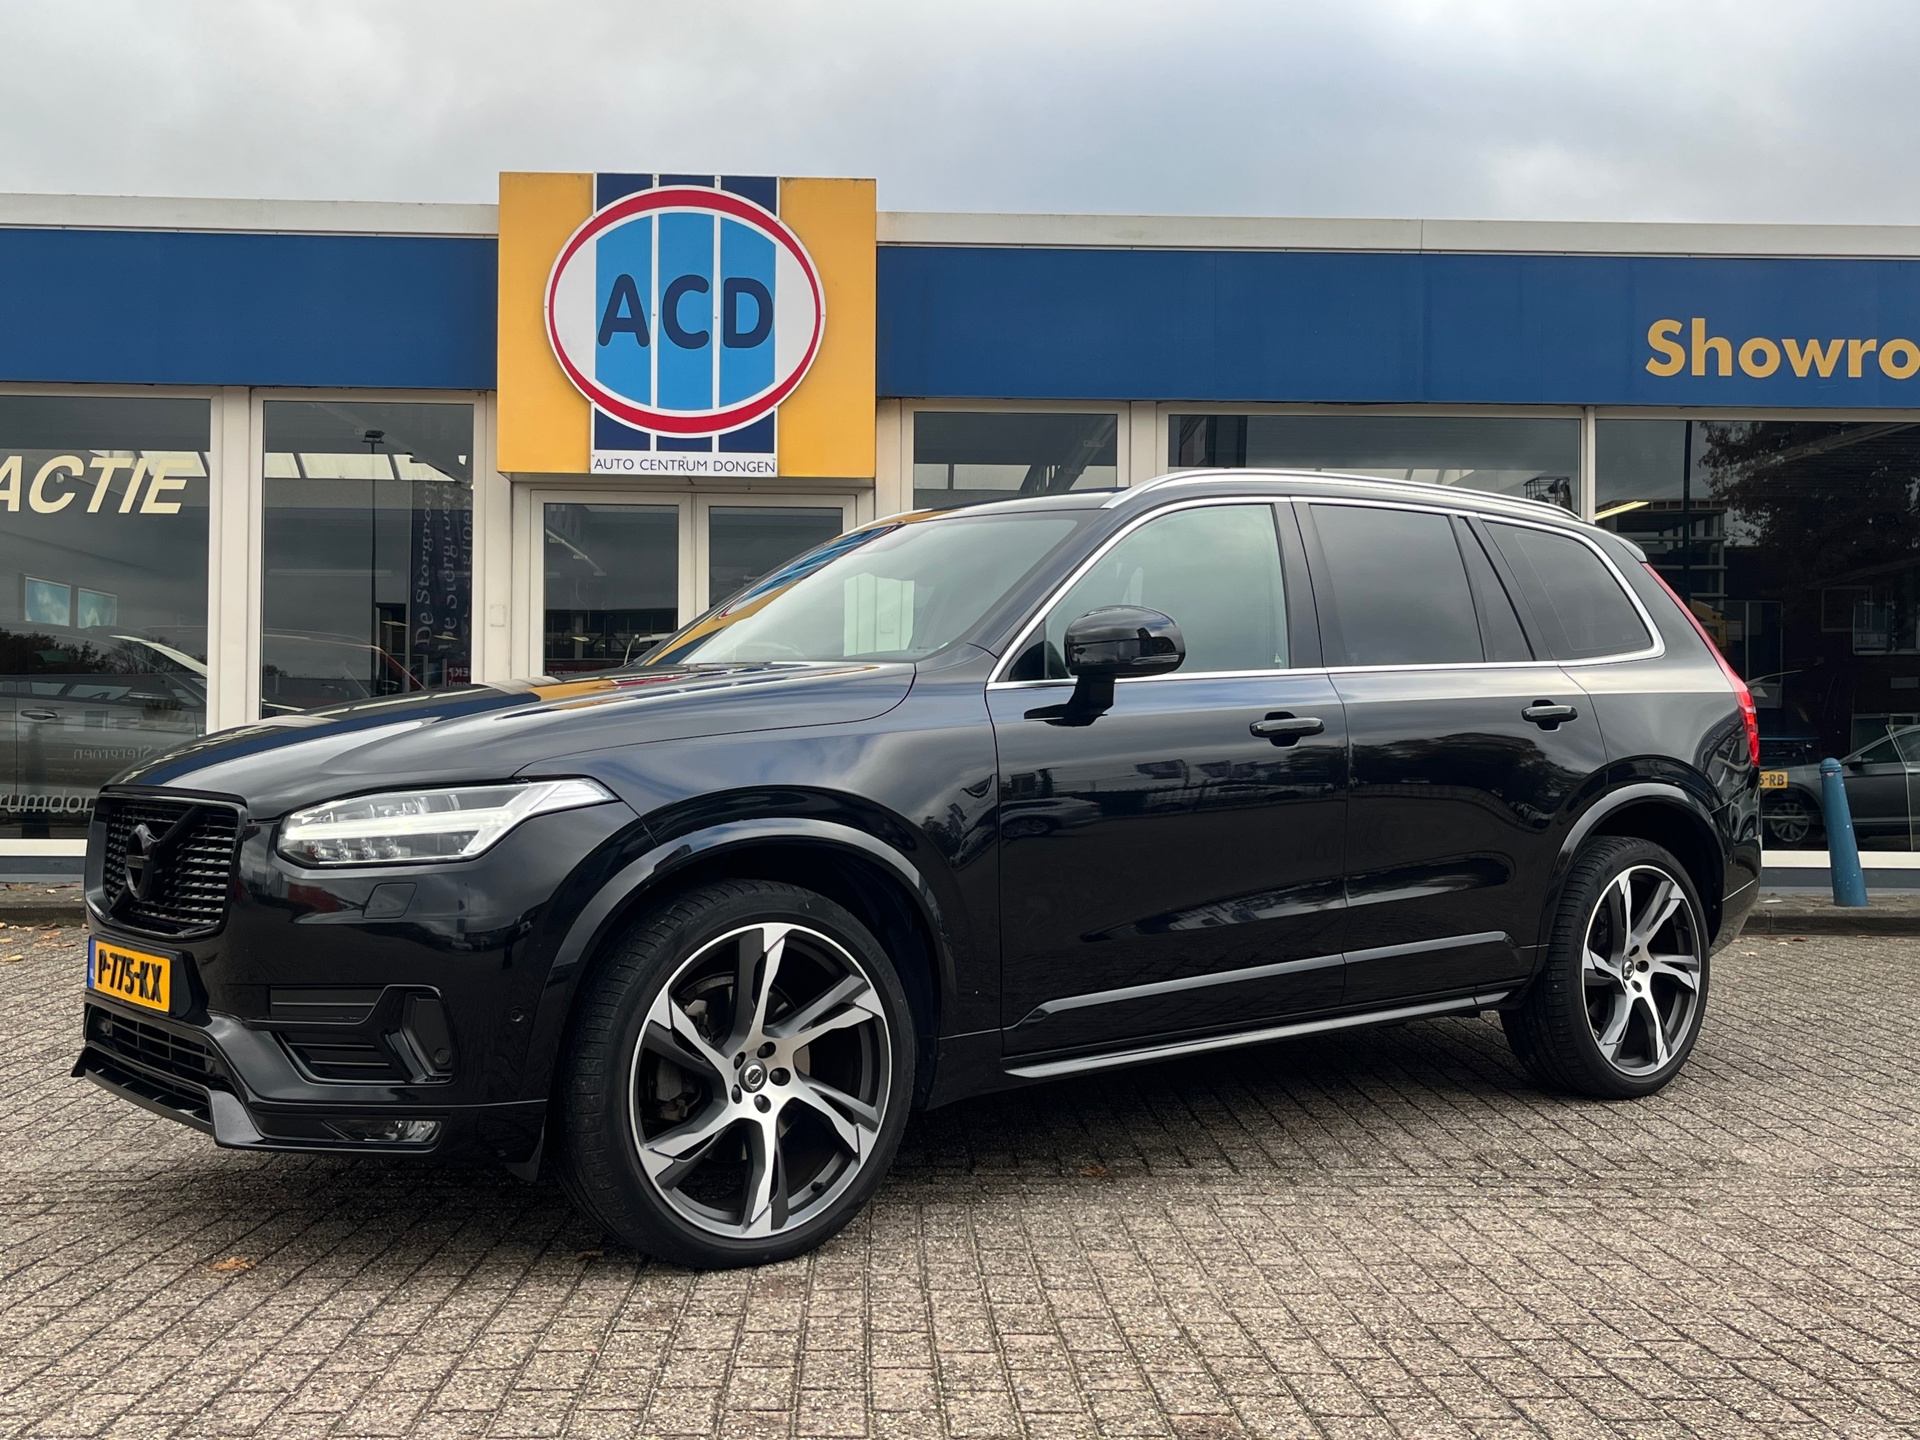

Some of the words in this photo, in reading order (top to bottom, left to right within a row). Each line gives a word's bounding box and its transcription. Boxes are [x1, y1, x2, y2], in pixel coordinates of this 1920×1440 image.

[598, 274, 774, 350] ACD
[1645, 317, 1920, 380] Showro
[0, 455, 197, 514] ACTIE
[594, 458, 635, 471] AUTO
[639, 459, 708, 472] CENTRUM
[713, 460, 776, 473] DONGEN
[414, 612, 434, 646] De
[98, 949, 162, 1003] P-775-KX
